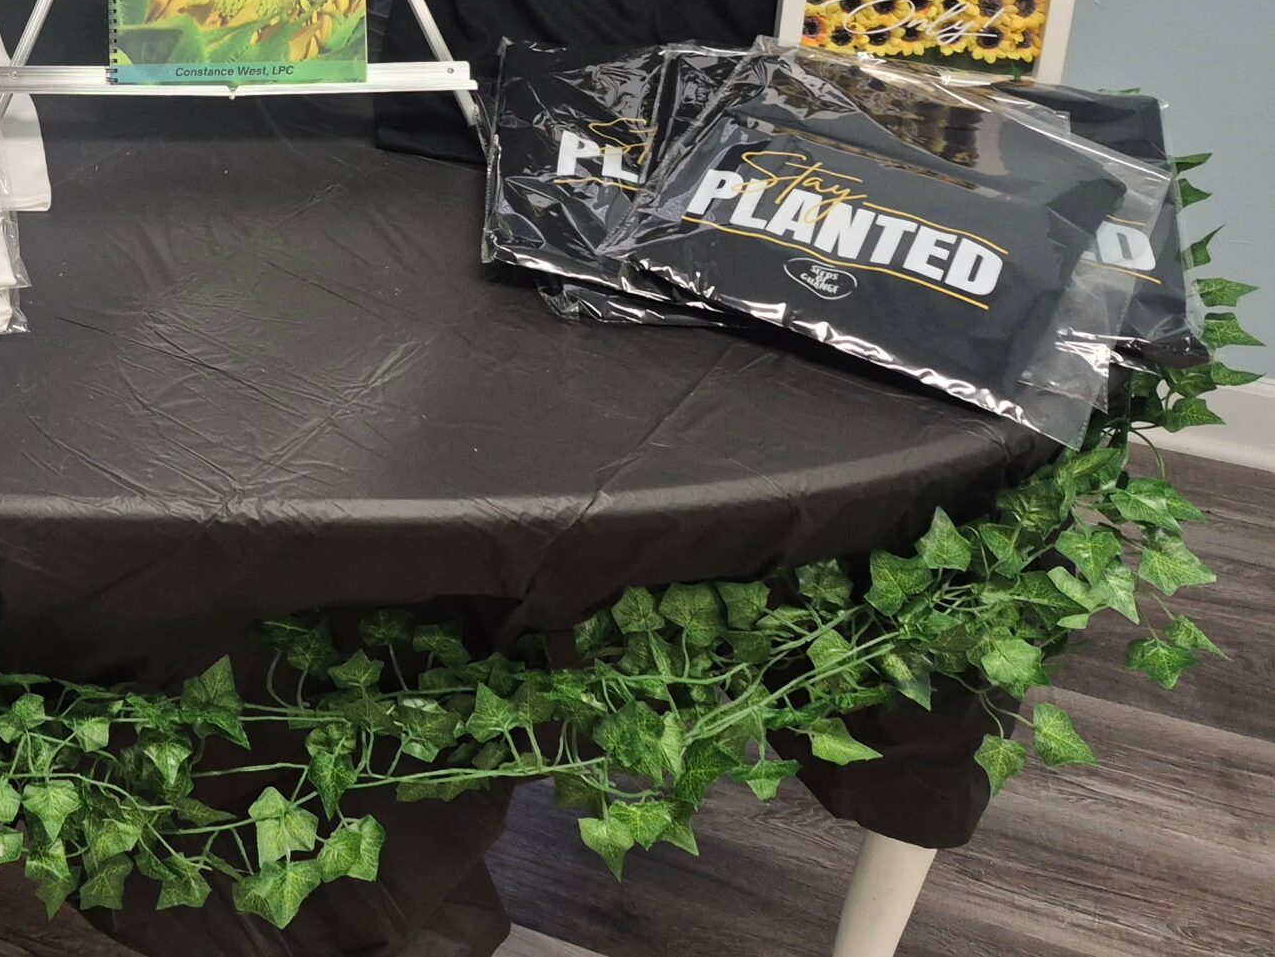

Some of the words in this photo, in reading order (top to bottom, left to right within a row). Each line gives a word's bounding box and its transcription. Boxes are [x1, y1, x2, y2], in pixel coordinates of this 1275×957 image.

[175, 67, 234, 77] Constance
[237, 66, 269, 76] West,
[272, 65, 294, 75] LPC
[732, 151, 867, 224] Stay
[685, 168, 1004, 296] PLANTED
